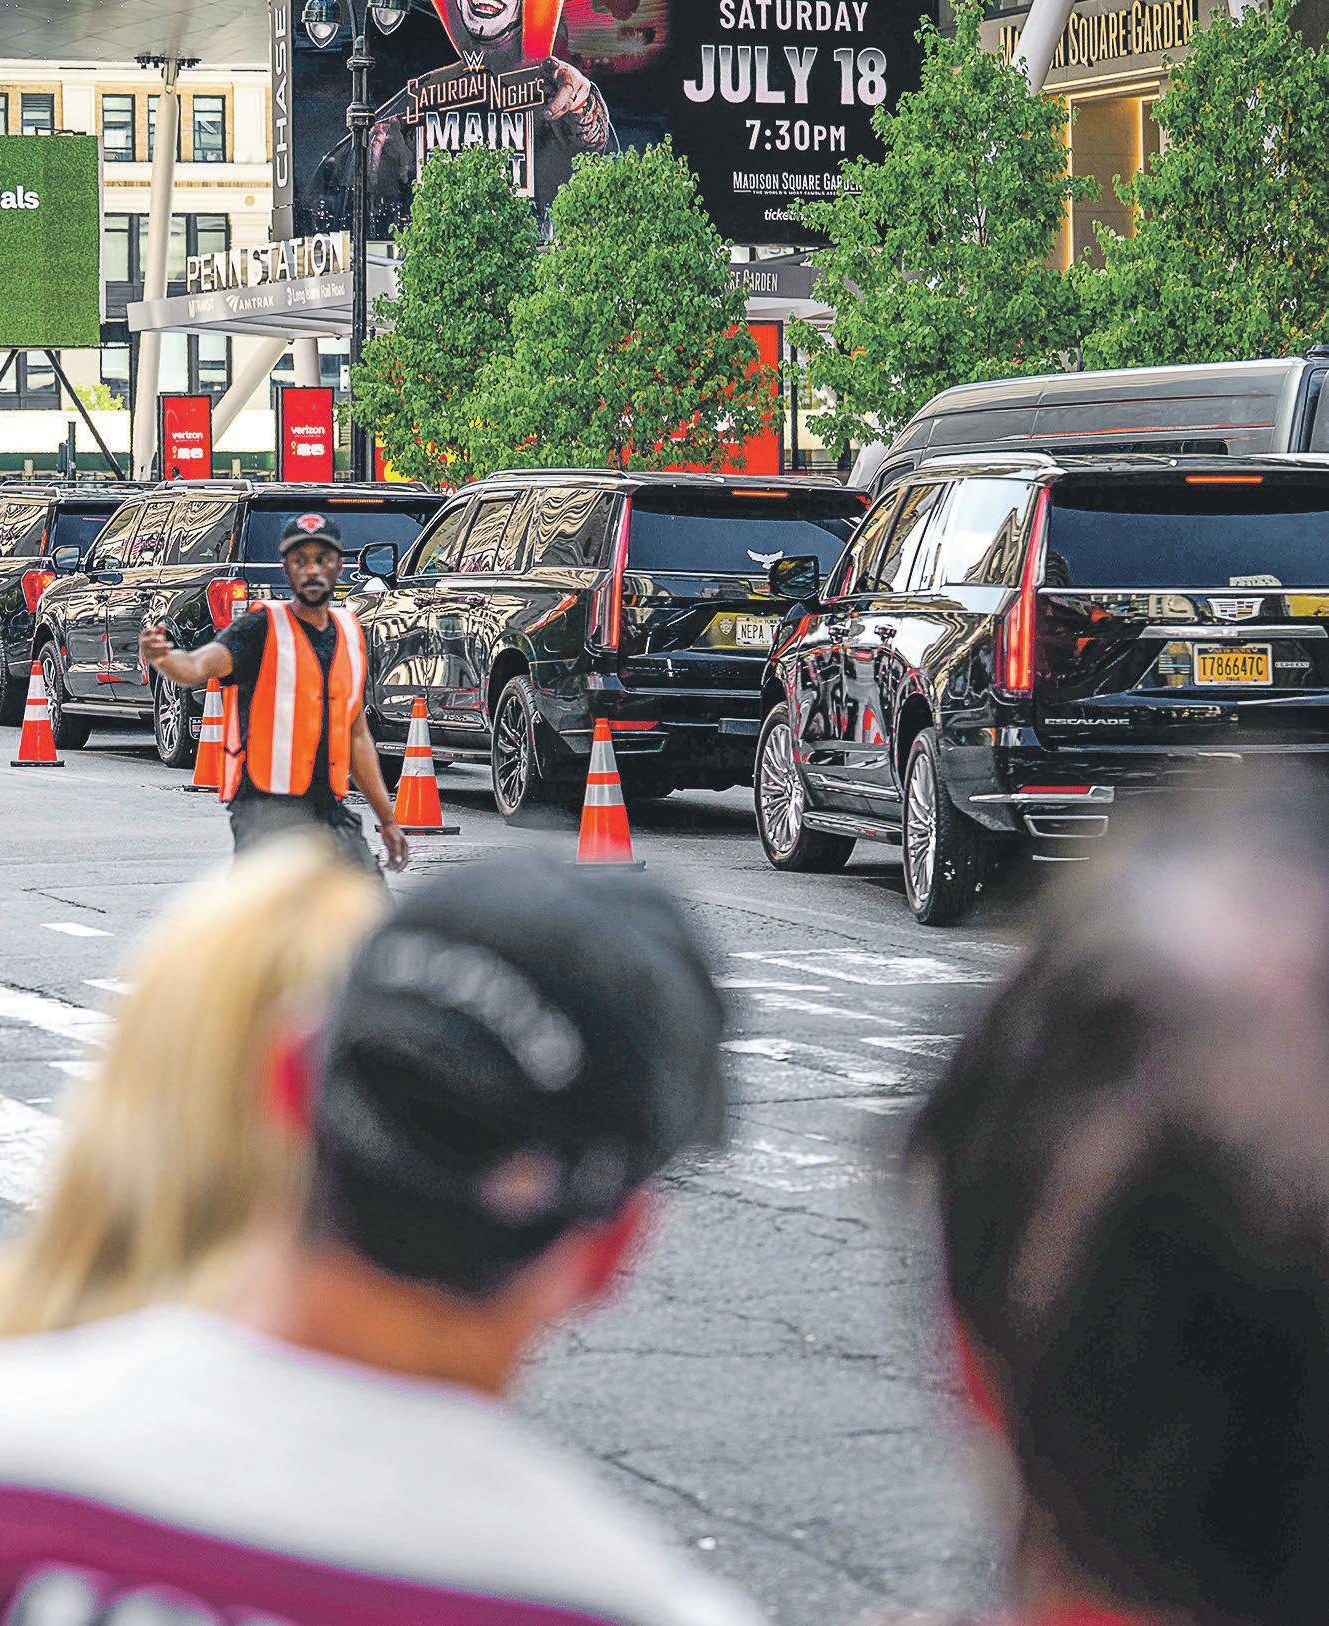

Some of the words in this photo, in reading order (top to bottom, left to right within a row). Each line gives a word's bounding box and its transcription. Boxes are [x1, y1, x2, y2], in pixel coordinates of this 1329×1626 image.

[720, 0, 868, 31] SATURDAY
[1069, 12, 1128, 68] SQUARE
[1131, 0, 1196, 55] GARDEN
[683, 45, 818, 104] JULY
[833, 47, 887, 106] 18
[275, 8, 288, 188] CHASE
[426, 112, 525, 151] MAIN
[745, 119, 846, 151] 7:30PM
[733, 171, 779, 190] MADISON
[782, 172, 821, 192] SQUARE
[186, 250, 243, 293] PENN
[246, 231, 347, 289] STATION
[238, 294, 276, 312] AMTRAK
[171, 430, 204, 440] verizon
[290, 424, 326, 435] verizon
[740, 624, 765, 640] NEPA
[1200, 655, 1264, 677] T786647C
